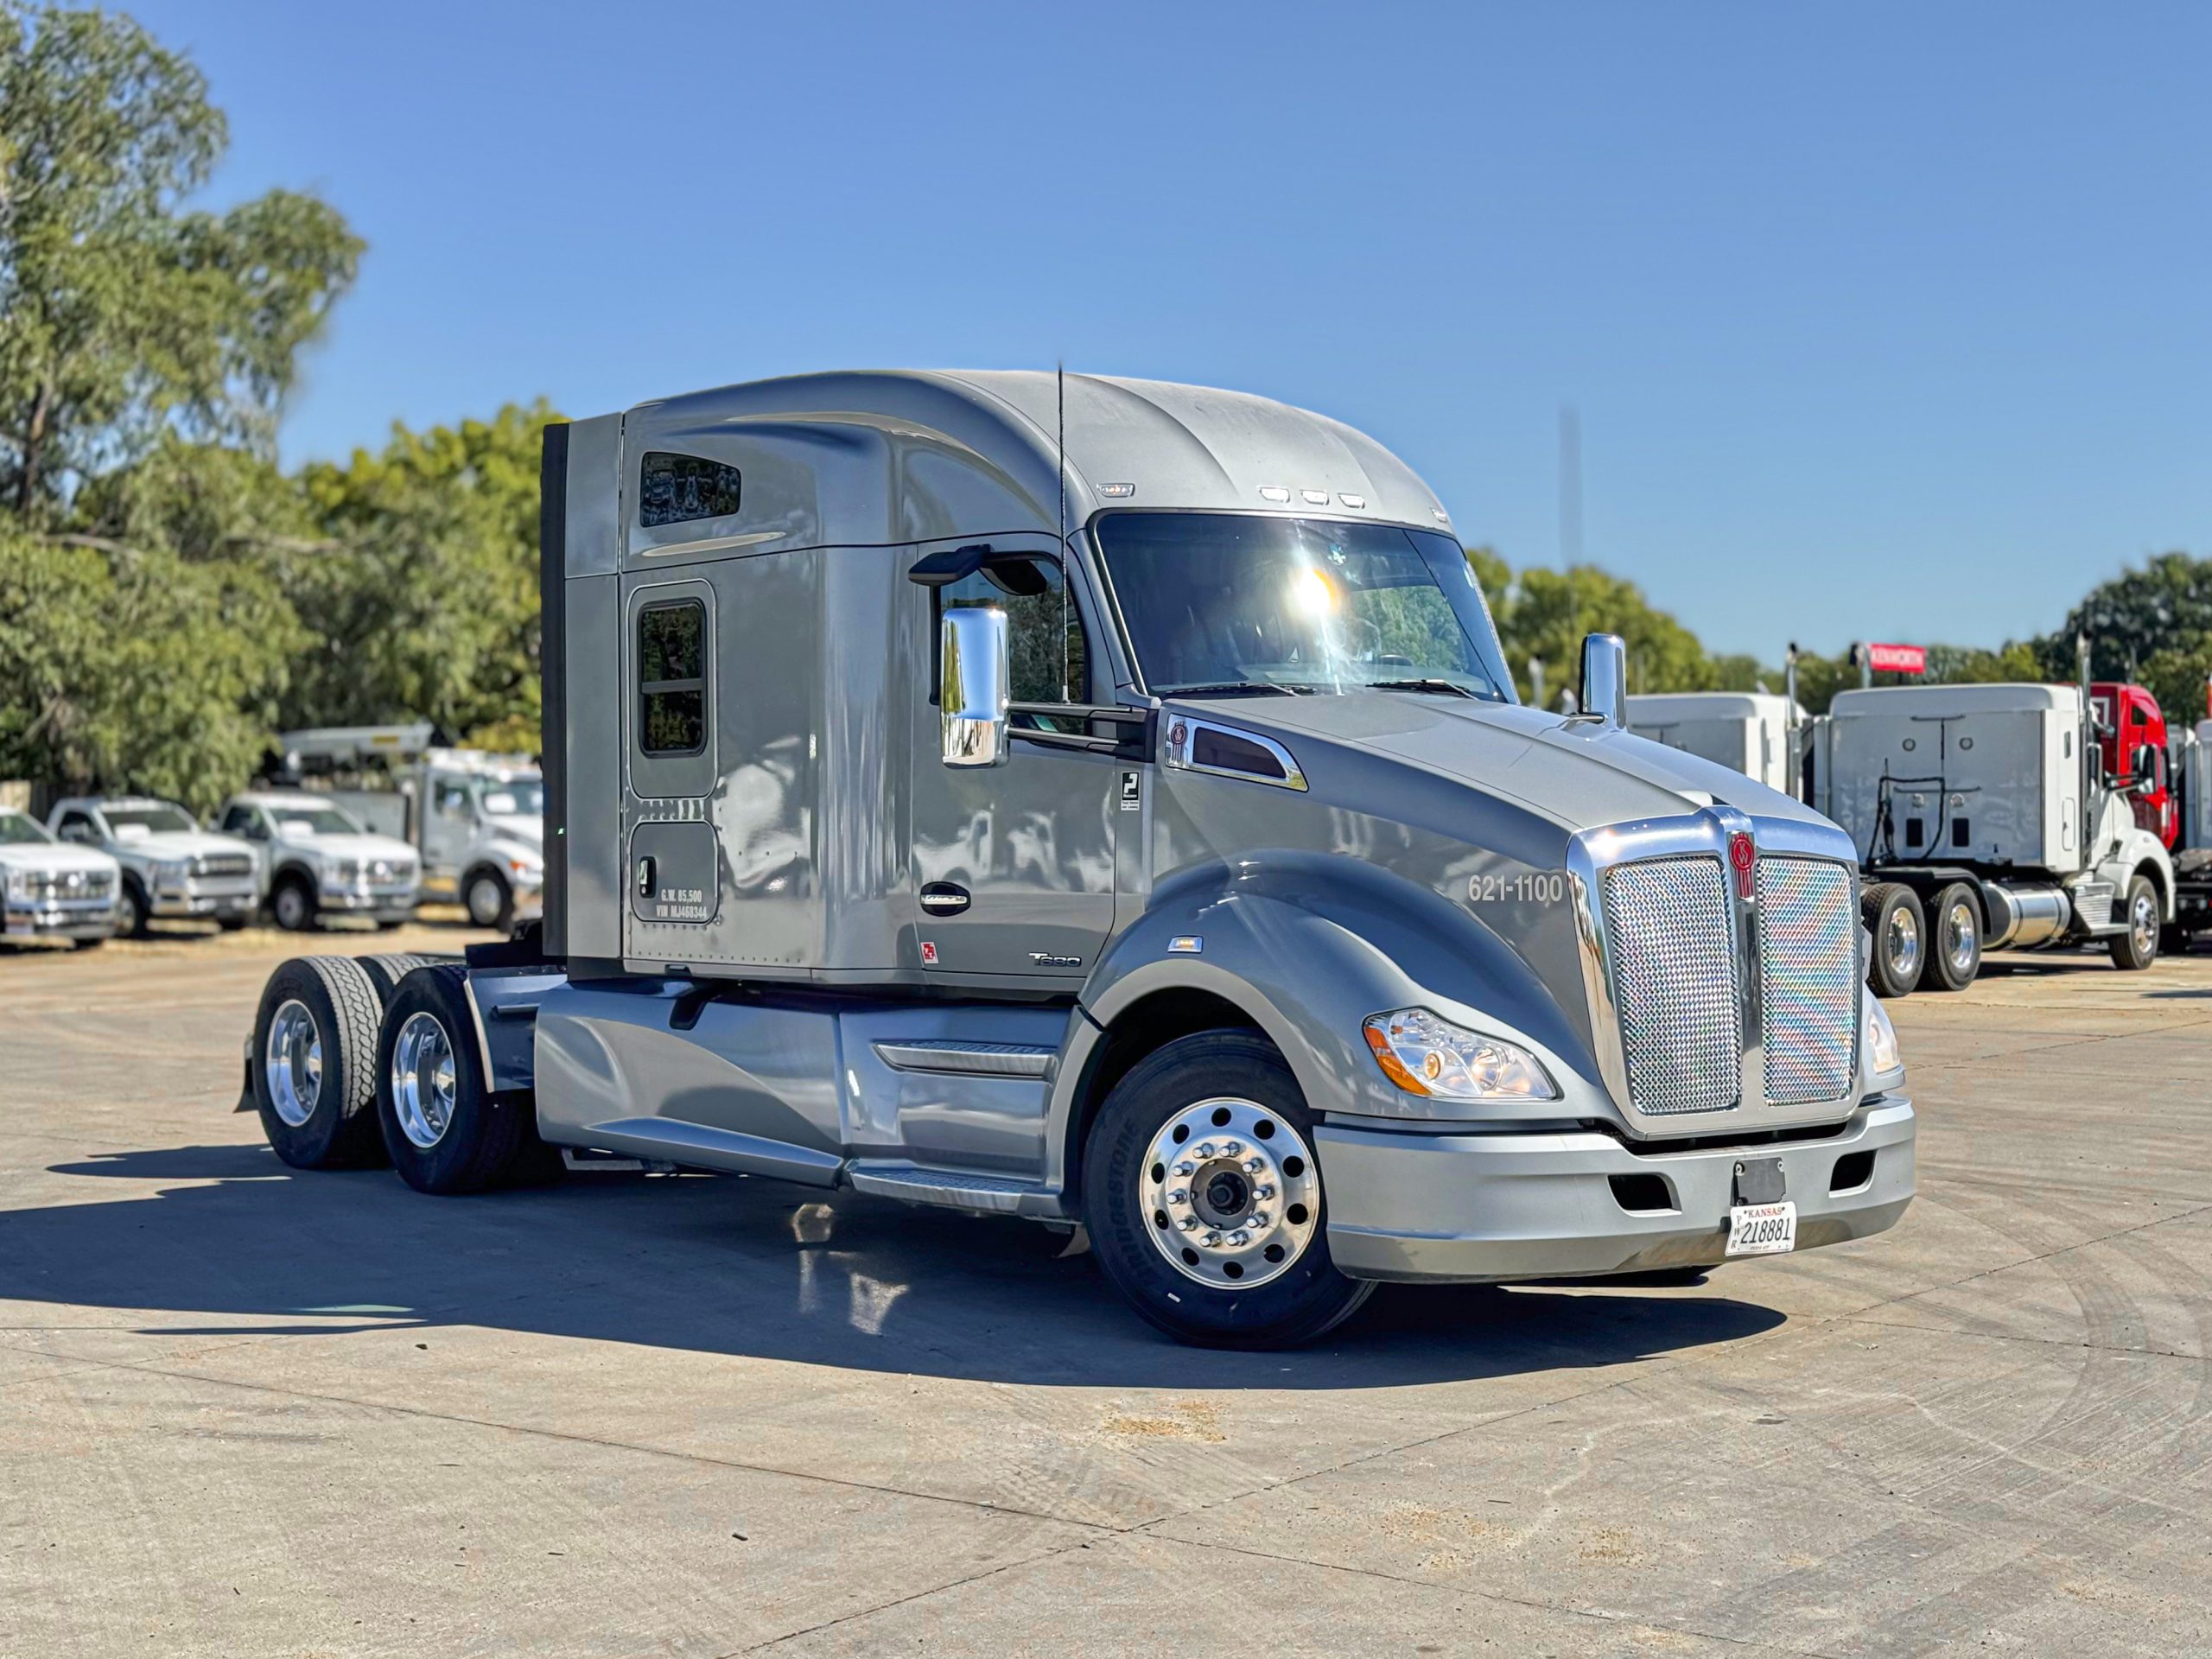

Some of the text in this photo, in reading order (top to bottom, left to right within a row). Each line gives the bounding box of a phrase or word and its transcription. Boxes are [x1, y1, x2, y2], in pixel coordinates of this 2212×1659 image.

[1469, 874, 1562, 901] 621-1100
[657, 904, 668, 917] VIN
[1748, 1207, 1783, 1218] KANSAS
[1740, 1217, 1790, 1244] 218881
